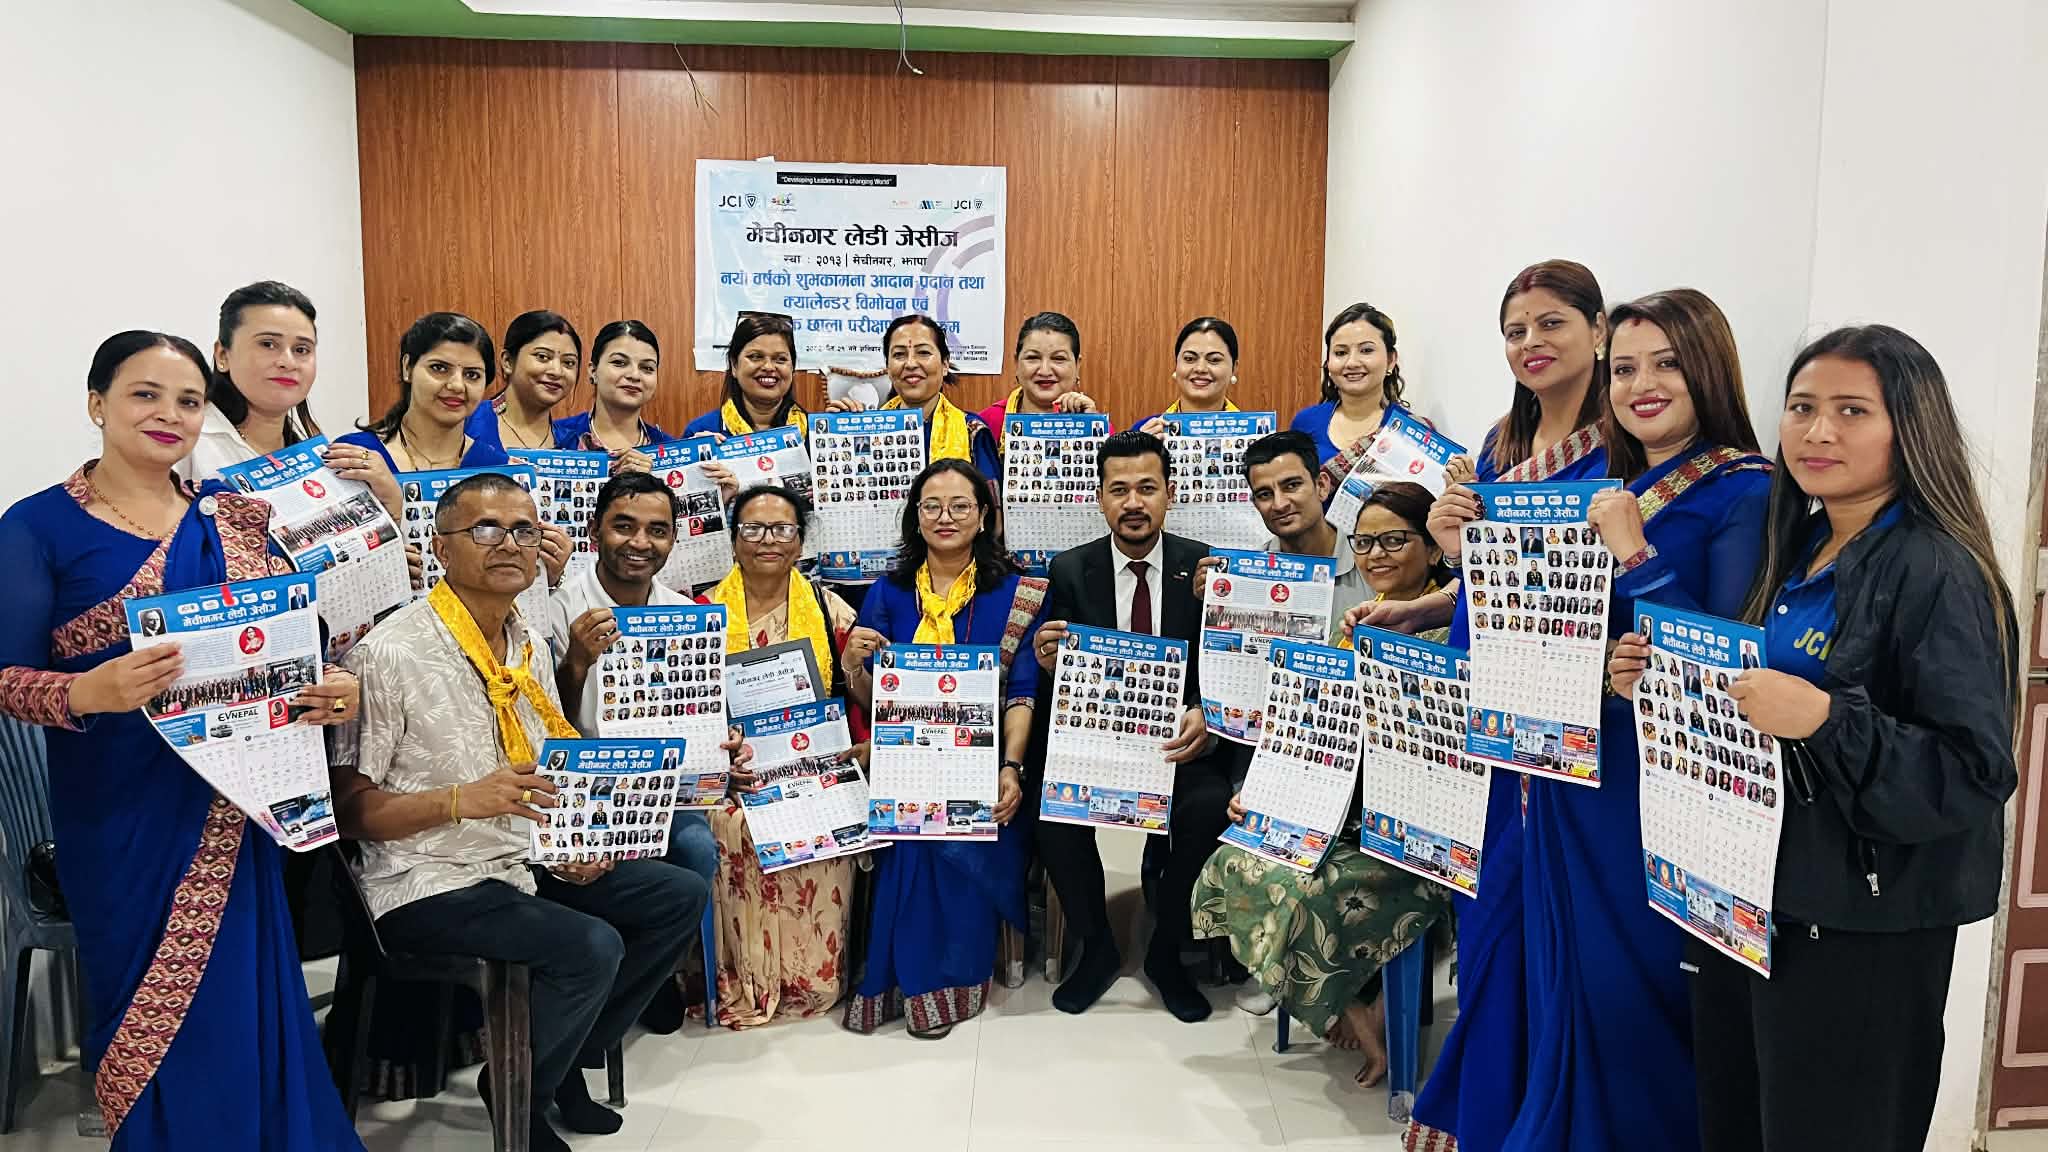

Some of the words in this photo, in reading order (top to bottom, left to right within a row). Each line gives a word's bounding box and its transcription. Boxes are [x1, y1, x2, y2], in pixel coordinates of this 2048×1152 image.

[849, 178, 874, 186] changing
[719, 195, 741, 207] JCI
[954, 200, 971, 210] JCI
[746, 222, 838, 245] मेचीनगर
[844, 224, 888, 246] लेडी
[895, 225, 959, 247] जेसीज
[816, 255, 842, 267] २०१३
[901, 257, 928, 267] झापा
[753, 269, 791, 286] वर्षको
[795, 273, 865, 290] शुभकामना
[958, 276, 985, 290] तथा
[784, 292, 852, 311] क्यालेन्डर
[856, 293, 906, 311] विमोचन
[912, 296, 929, 311] एवं
[807, 319, 842, 333] छाला
[1534, 507, 1551, 518] लेडी
[1553, 507, 1580, 518] जेसीज
[183, 611, 225, 627] मेचीनगर
[227, 606, 247, 620] लेडी
[249, 603, 277, 616] जेसीज
[1794, 627, 1833, 661] JCI
